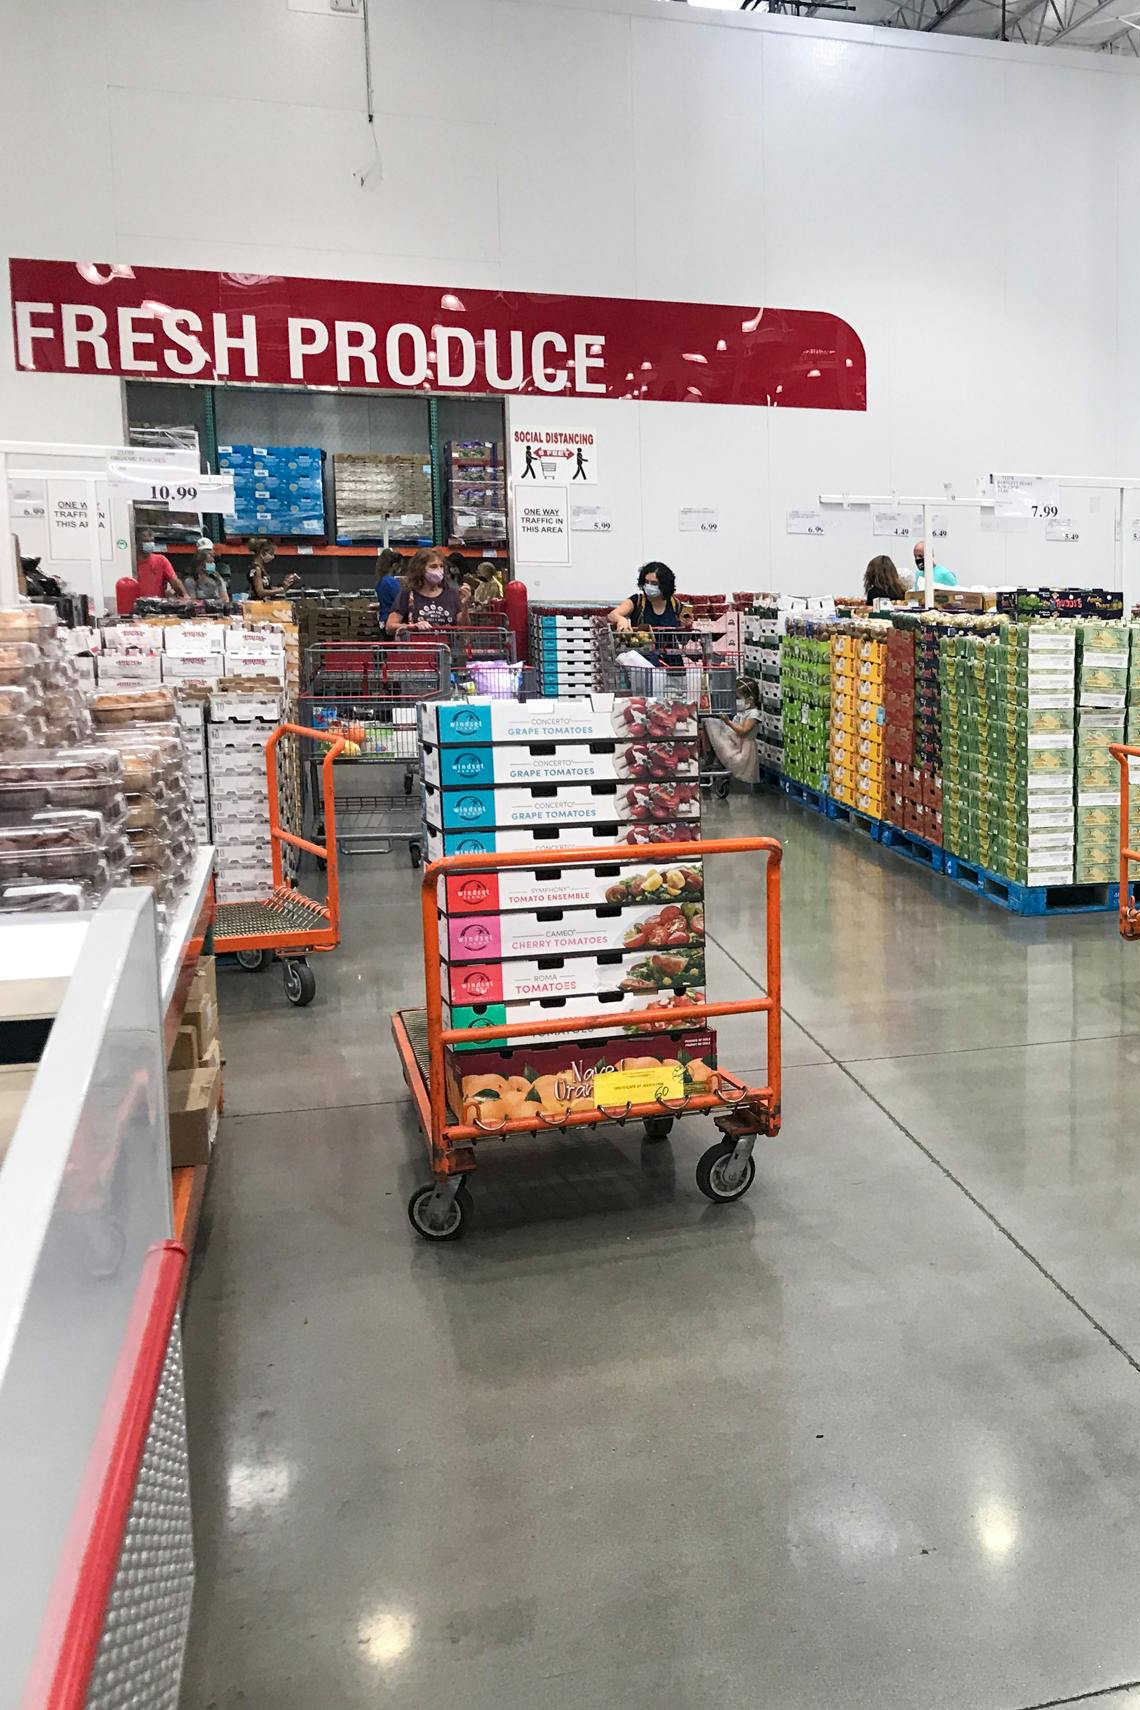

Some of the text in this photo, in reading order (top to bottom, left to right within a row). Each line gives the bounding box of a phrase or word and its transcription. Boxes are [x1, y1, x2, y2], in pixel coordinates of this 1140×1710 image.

[14, 301, 607, 394] FRESH PRODUCE
[514, 431, 594, 446] SOCIAL DISTANCING
[546, 450, 571, 458] FEET
[150, 485, 198, 501] 10.99
[57, 501, 78, 509] ONE
[54, 511, 88, 519] TRAFFI
[523, 508, 560, 516] ONE WAY
[1031, 505, 1058, 518] 7.99
[56, 521, 77, 529] THIS
[521, 517, 564, 525] TRAFFIC IN
[522, 526, 563, 534] THIS AREA
[593, 522, 611, 530] 5.99
[700, 523, 718, 531] 6.99
[893, 527, 909, 536] 4.49
[932, 529, 947, 537] 6.49
[1065, 533, 1079, 541] 5.49
[508, 726, 593, 736] GRAPE TOMATOES
[510, 768, 595, 778] GRAPE TOMATOES
[511, 810, 597, 820] GRAPE TOMATOES
[509, 892, 590, 904] TOMATO ENSEMBLE
[545, 929, 574, 938] CAMEO
[512, 936, 608, 950] CHERRY TOMATOES
[533, 974, 558, 982] ROMA
[515, 981, 577, 994] TOMATOES
